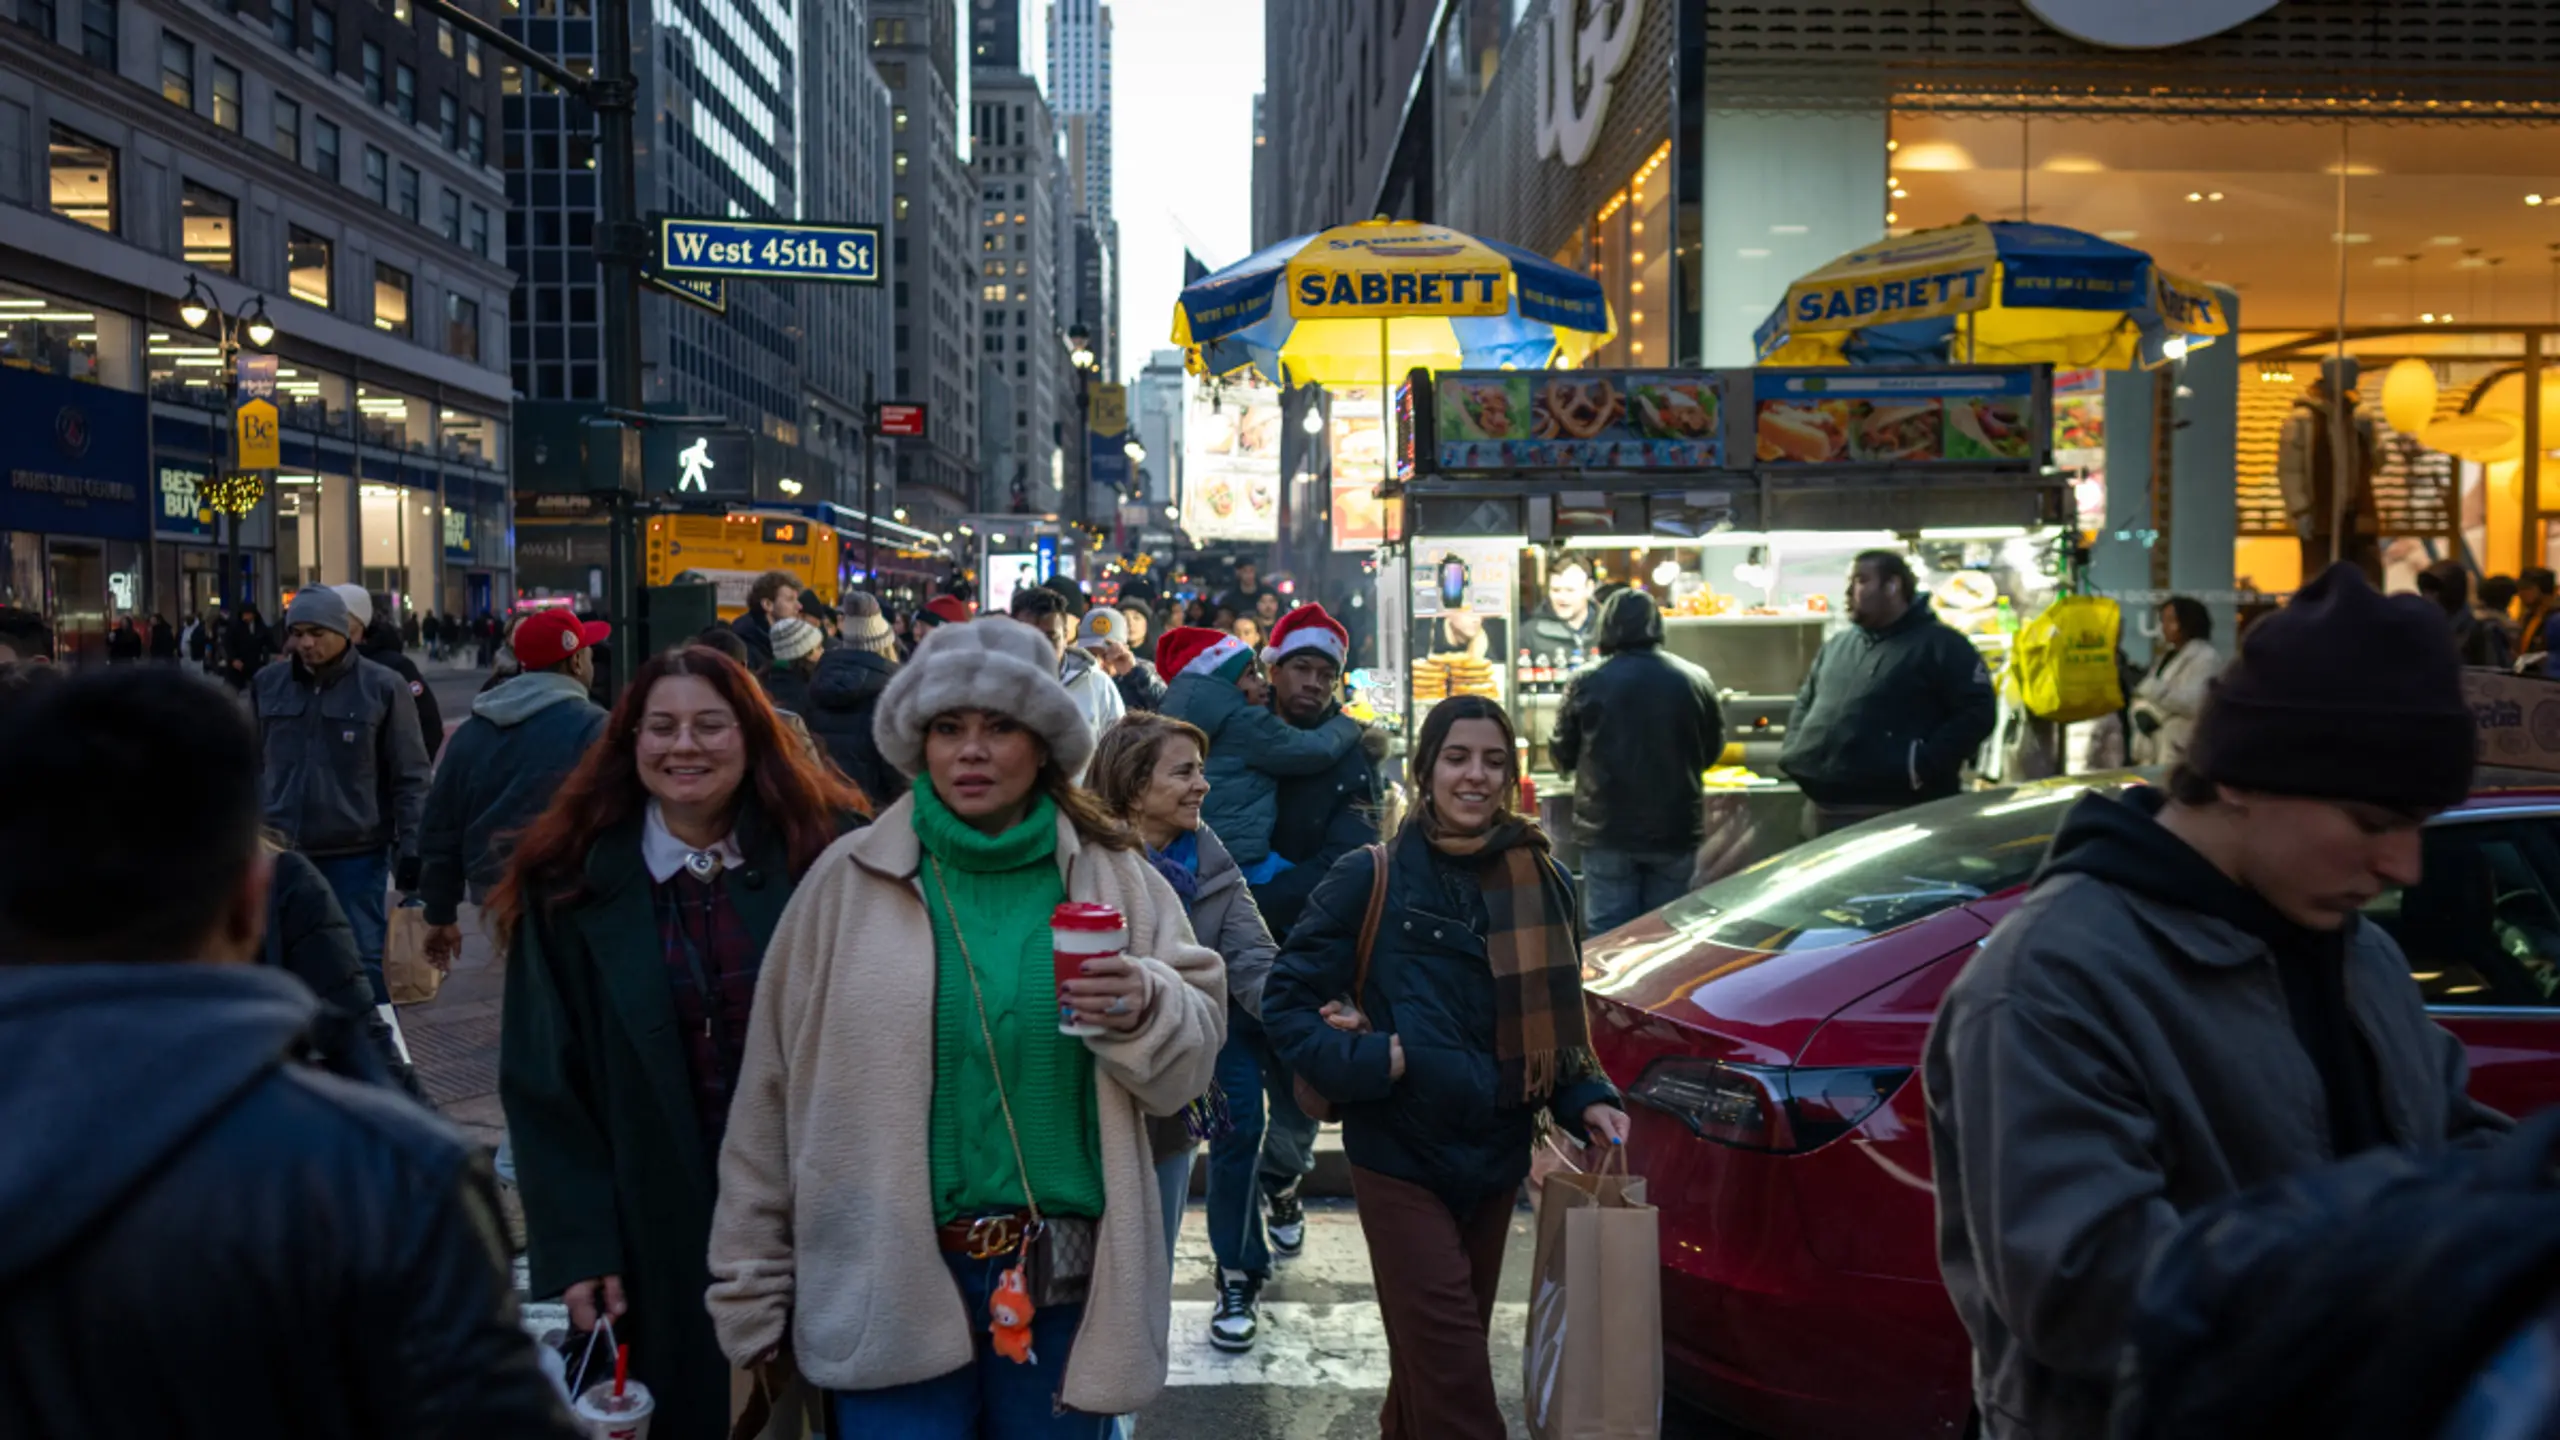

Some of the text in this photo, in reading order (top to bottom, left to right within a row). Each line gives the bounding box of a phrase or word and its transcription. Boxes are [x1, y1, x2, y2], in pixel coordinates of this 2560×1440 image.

[673, 231, 871, 271] West 45th St
[1299, 271, 1502, 306] SABRETT
[1797, 268, 1986, 322] SABRETT
[159, 467, 205, 495] BEST
[163, 492, 203, 521] BUY
